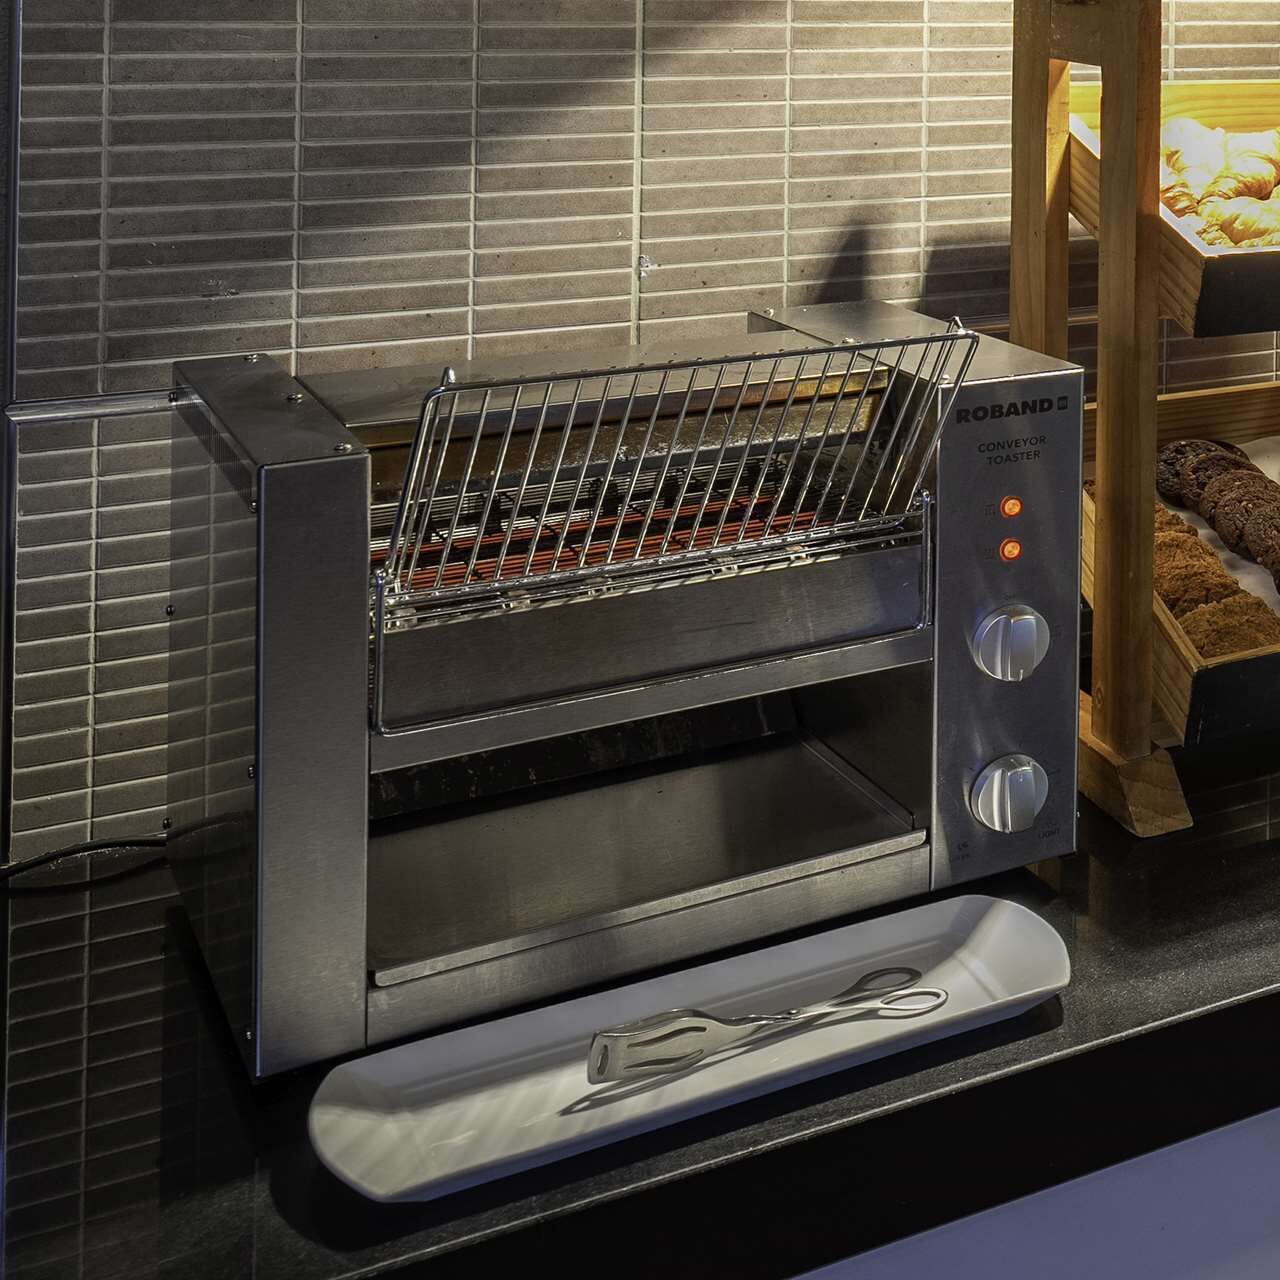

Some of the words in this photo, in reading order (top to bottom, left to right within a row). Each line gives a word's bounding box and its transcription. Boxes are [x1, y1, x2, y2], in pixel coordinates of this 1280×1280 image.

[956, 398, 1054, 424] ROBAND
[977, 435, 1048, 453] CONVEYOR
[986, 450, 1042, 466] TOASTER
